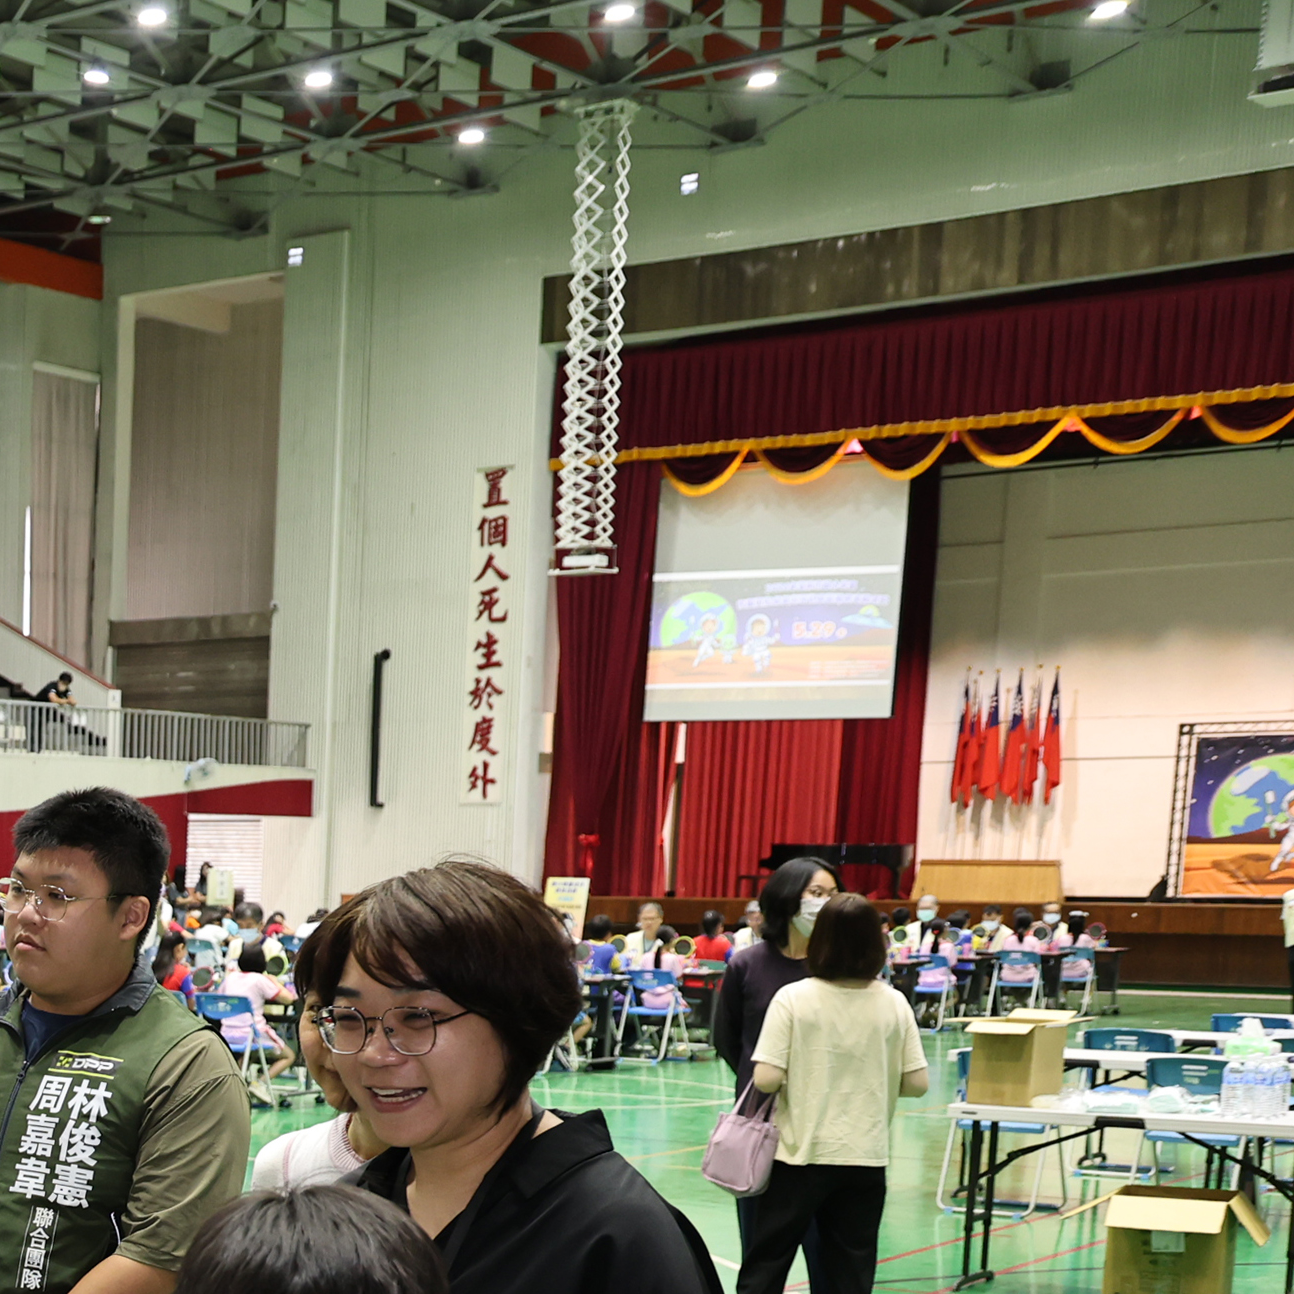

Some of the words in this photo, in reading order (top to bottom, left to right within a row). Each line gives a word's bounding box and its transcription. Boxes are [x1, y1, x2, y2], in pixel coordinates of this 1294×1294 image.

[468, 467, 511, 800] 置個人死生於度外
[72, 1058, 114, 1071] DPP
[9, 1075, 73, 1199] 周嘉韋
[48, 1079, 112, 1209] 林俊憲
[21, 1207, 54, 1290] 聯合團隊
